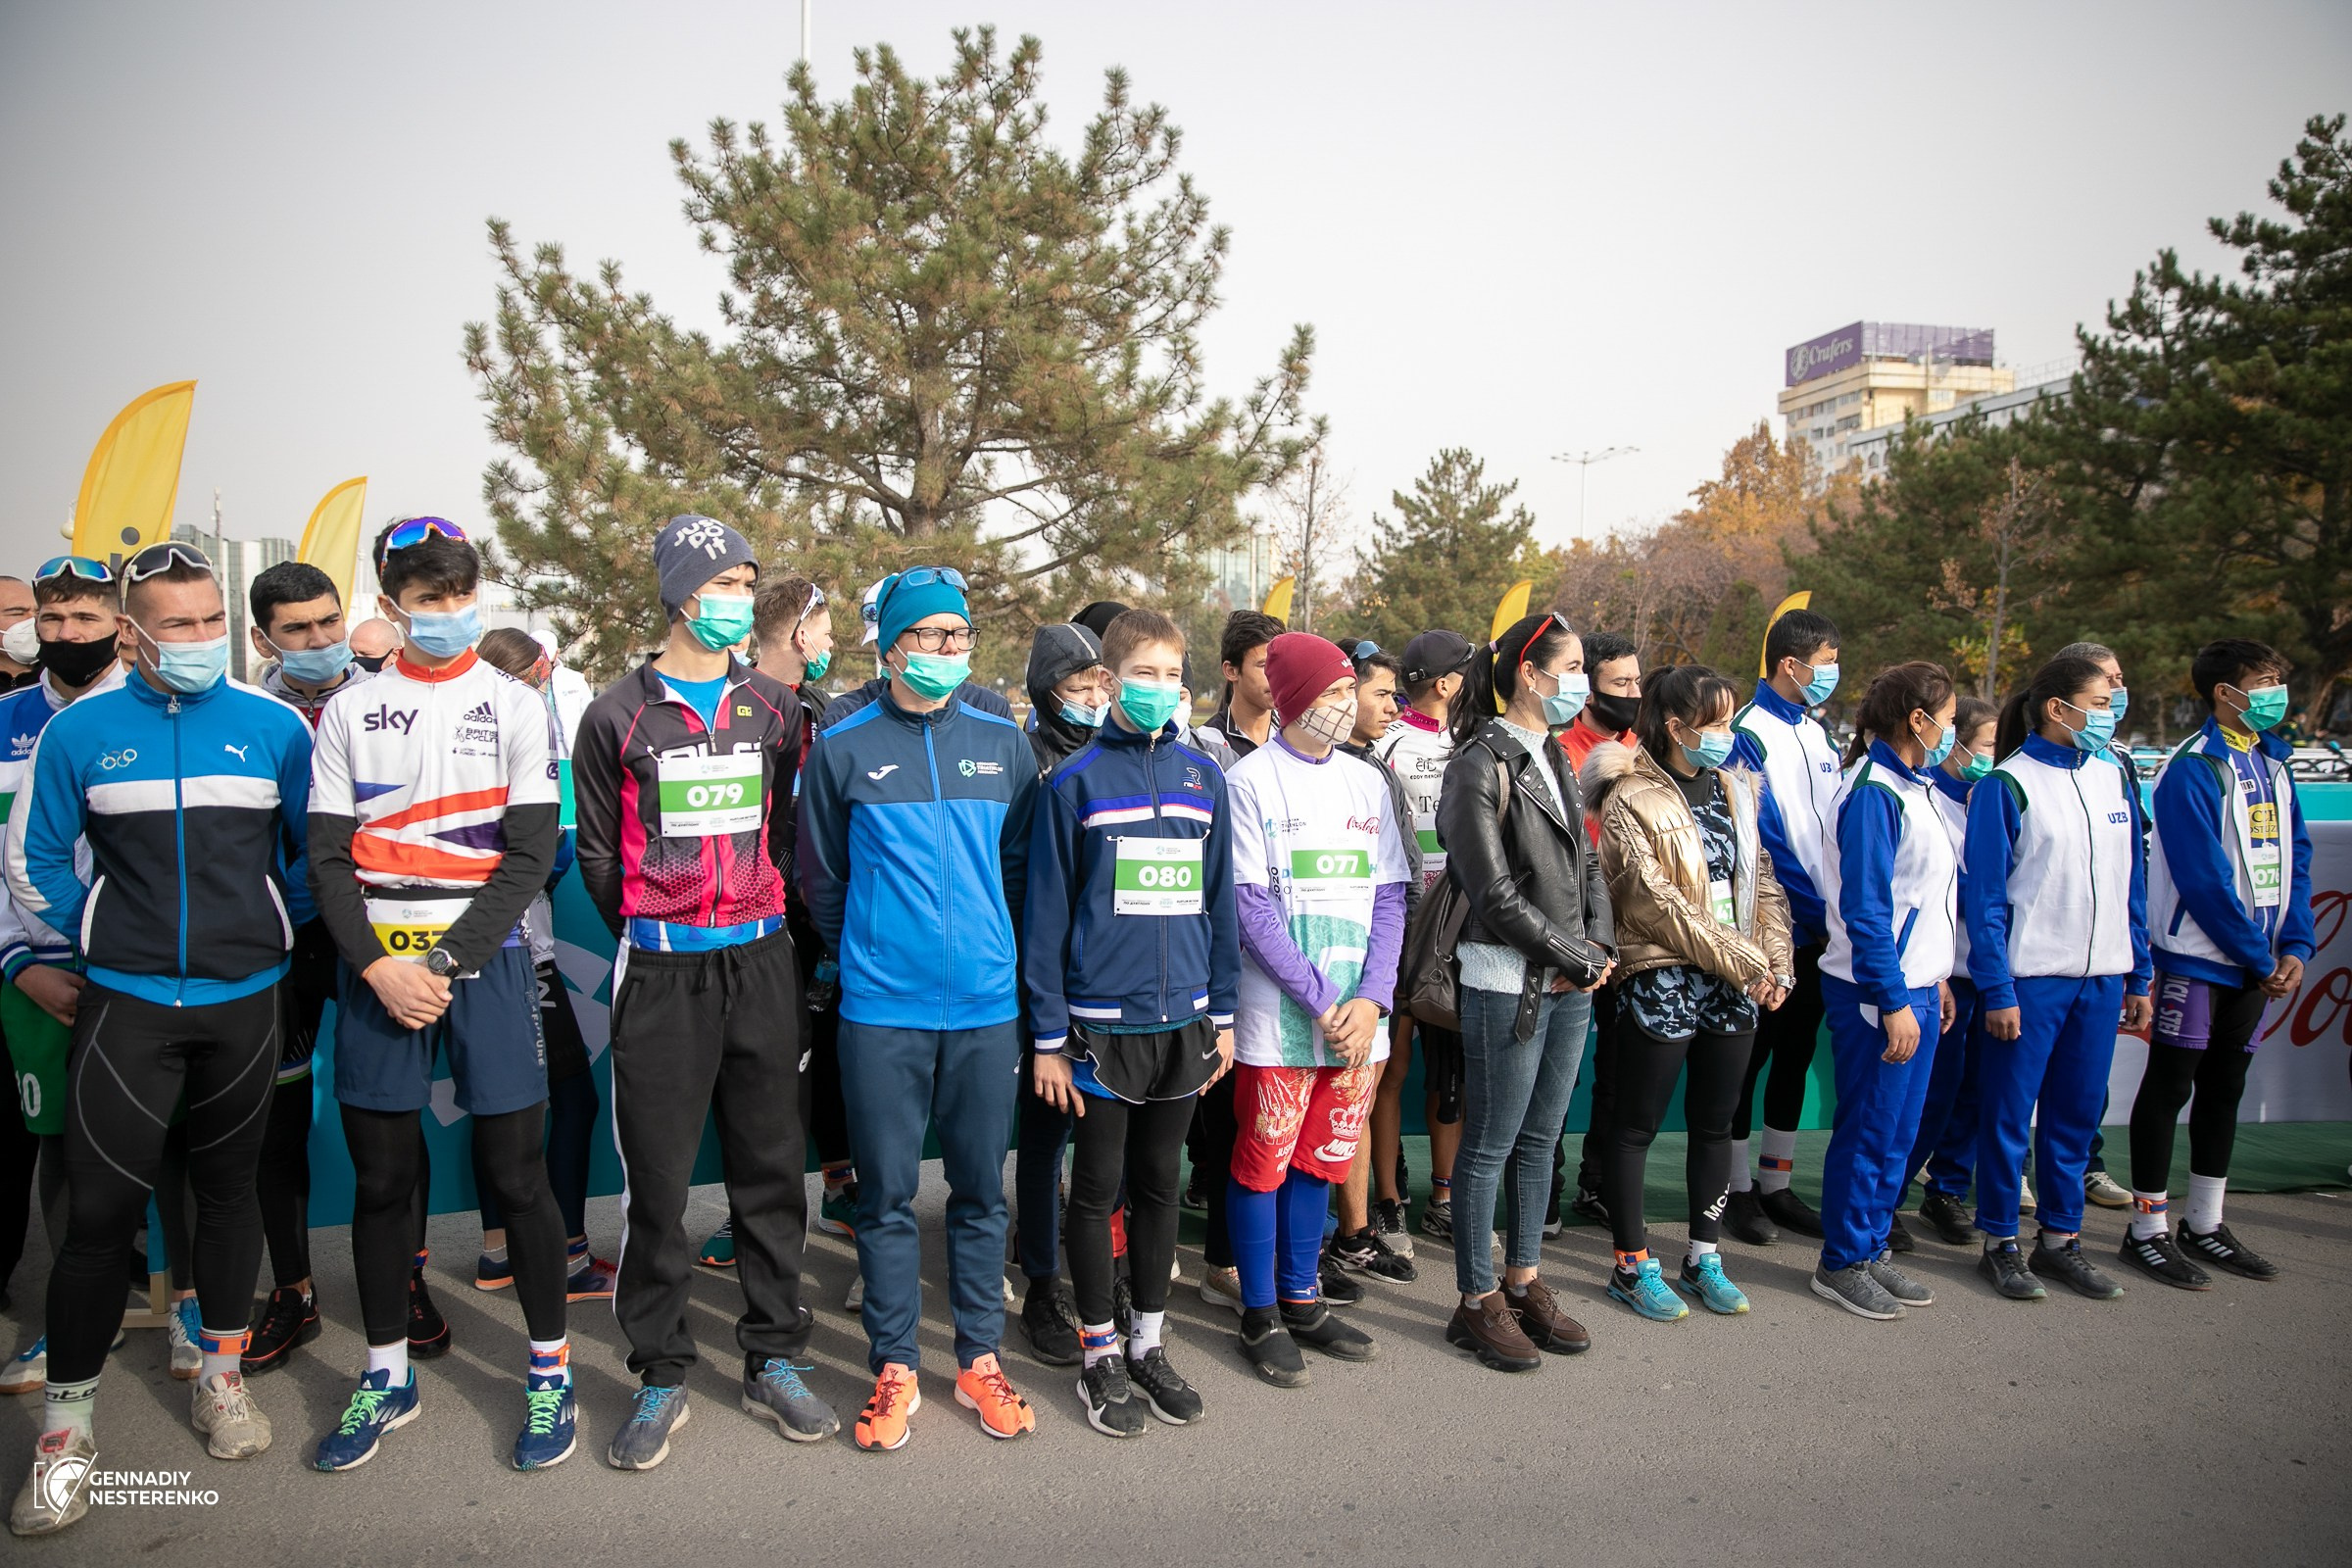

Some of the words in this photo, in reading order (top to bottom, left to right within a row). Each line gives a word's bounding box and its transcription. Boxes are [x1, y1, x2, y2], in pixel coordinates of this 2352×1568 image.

[673, 518, 725, 547] JUST
[688, 525, 725, 549] DO
[363, 704, 419, 736] sky
[687, 783, 744, 808] 079
[2108, 811, 2129, 824] UZB
[1138, 865, 1192, 888] 080
[1316, 855, 1358, 874] 077
[1270, 866, 1282, 903] 2020
[15, 1069, 41, 1117] 0
[1324, 1138, 1359, 1156] NIKE
